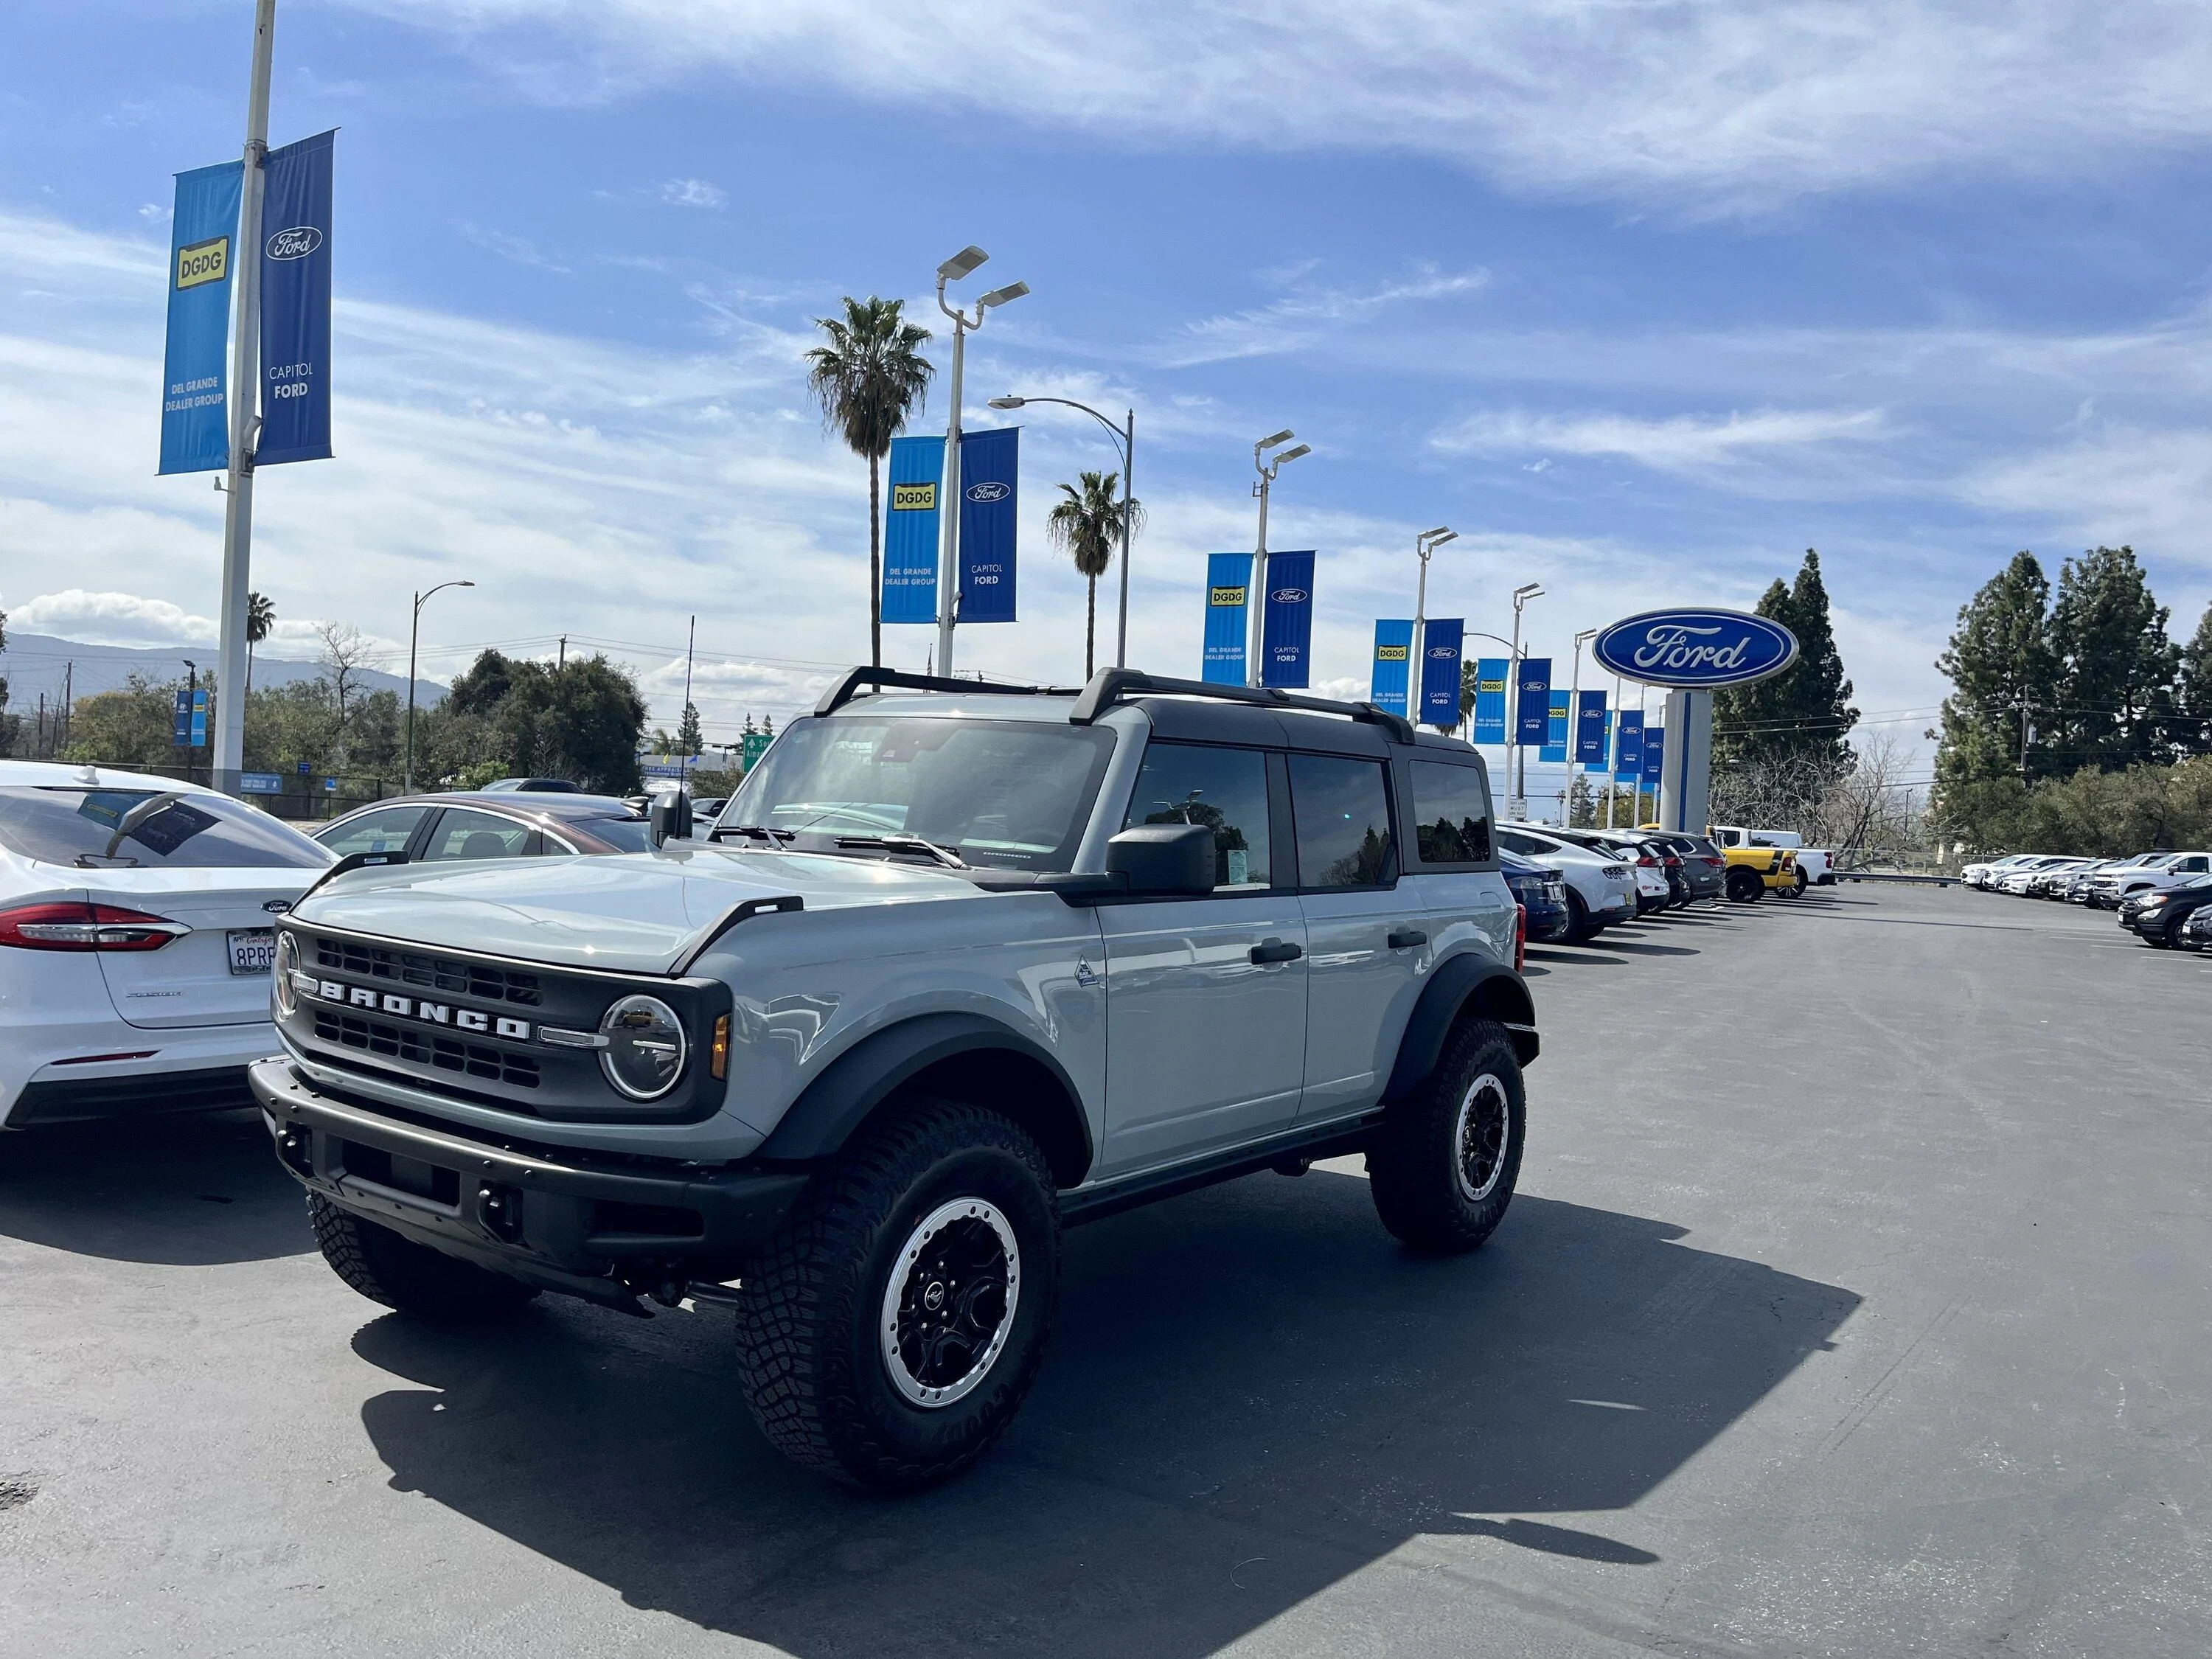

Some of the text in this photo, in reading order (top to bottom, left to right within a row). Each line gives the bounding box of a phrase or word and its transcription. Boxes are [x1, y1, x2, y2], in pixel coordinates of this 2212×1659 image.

[275, 231, 311, 255] Ford
[181, 251, 222, 279] DGDG
[269, 362, 313, 380] CAPITOL
[172, 376, 218, 395] DEL GRANDE
[274, 383, 308, 399] FORD
[166, 393, 223, 411] DEALER GROUP
[897, 491, 932, 504] DGDG
[975, 485, 1001, 499] Ford
[971, 564, 1003, 574] CAPITOL
[975, 576, 999, 585] FORD
[1214, 593, 1242, 601] DGDG
[1279, 591, 1301, 600] Ford
[1433, 649, 1452, 657] Ford
[1634, 625, 1751, 669] Ford
[747, 750, 762, 758] Alma
[268, 902, 287, 911] Ford
[247, 937, 272, 945] Califo
[320, 981, 530, 1040] BRONCO
